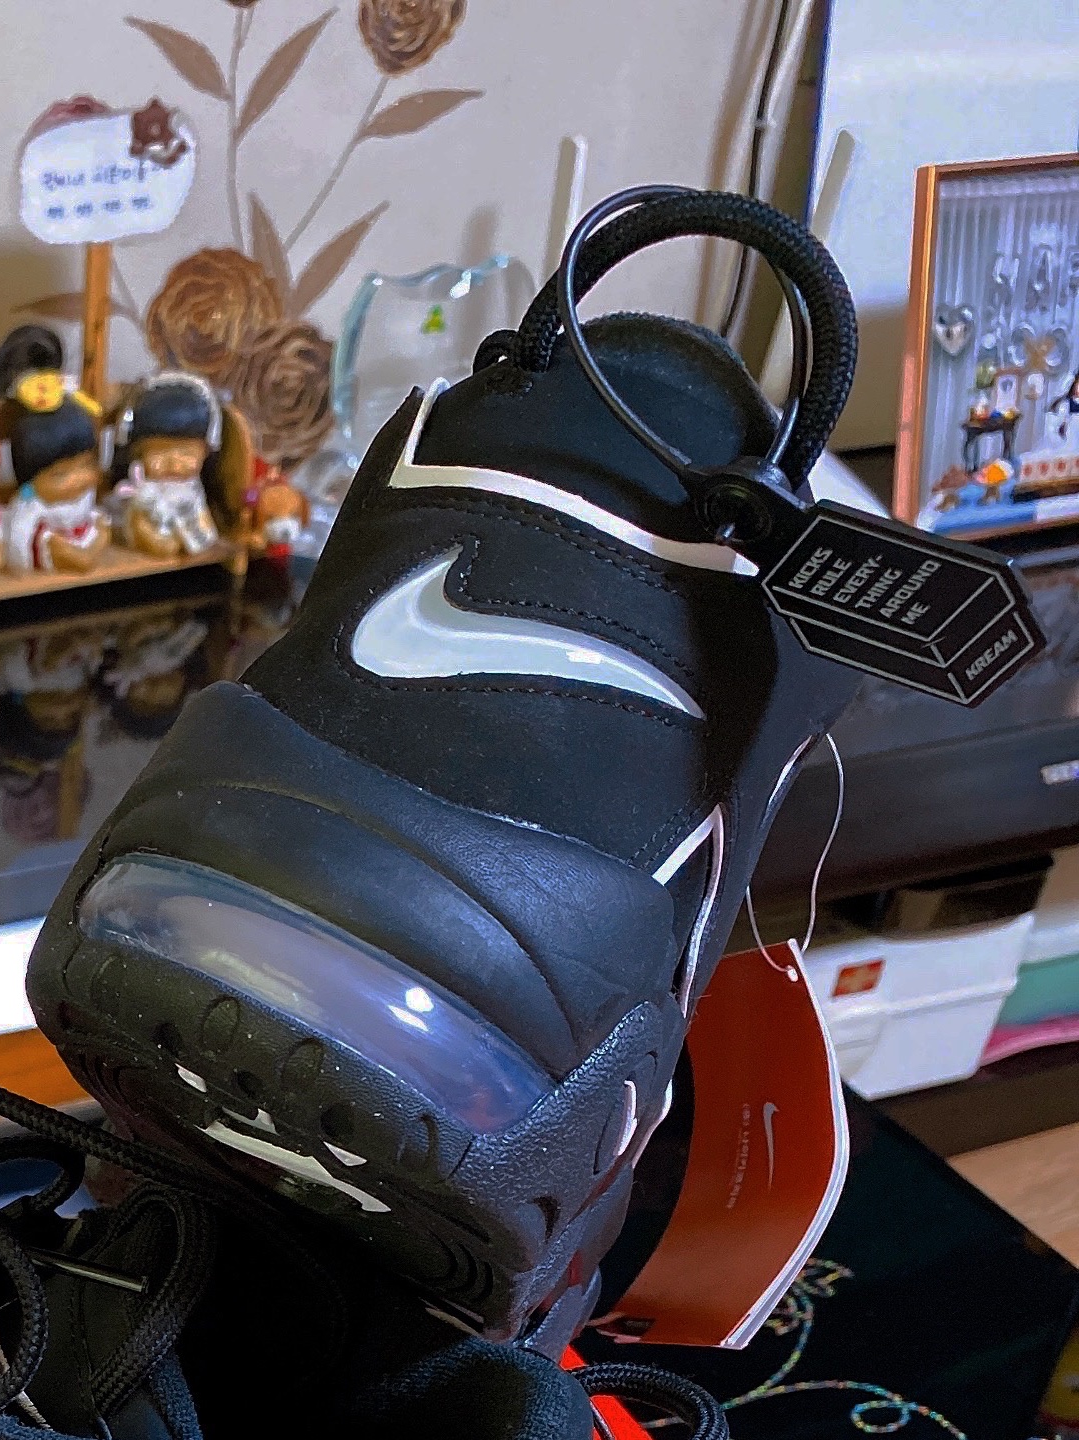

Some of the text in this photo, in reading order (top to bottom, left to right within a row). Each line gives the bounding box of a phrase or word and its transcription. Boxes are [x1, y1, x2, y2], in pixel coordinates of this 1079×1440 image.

[788, 547, 833, 589] KICKS
[810, 558, 852, 596] RULE
[833, 555, 883, 604] EVERY-
[855, 567, 903, 609] THING
[879, 559, 942, 619] AROUND
[901, 602, 931, 625] ME
[965, 629, 1019, 681] KREAM
